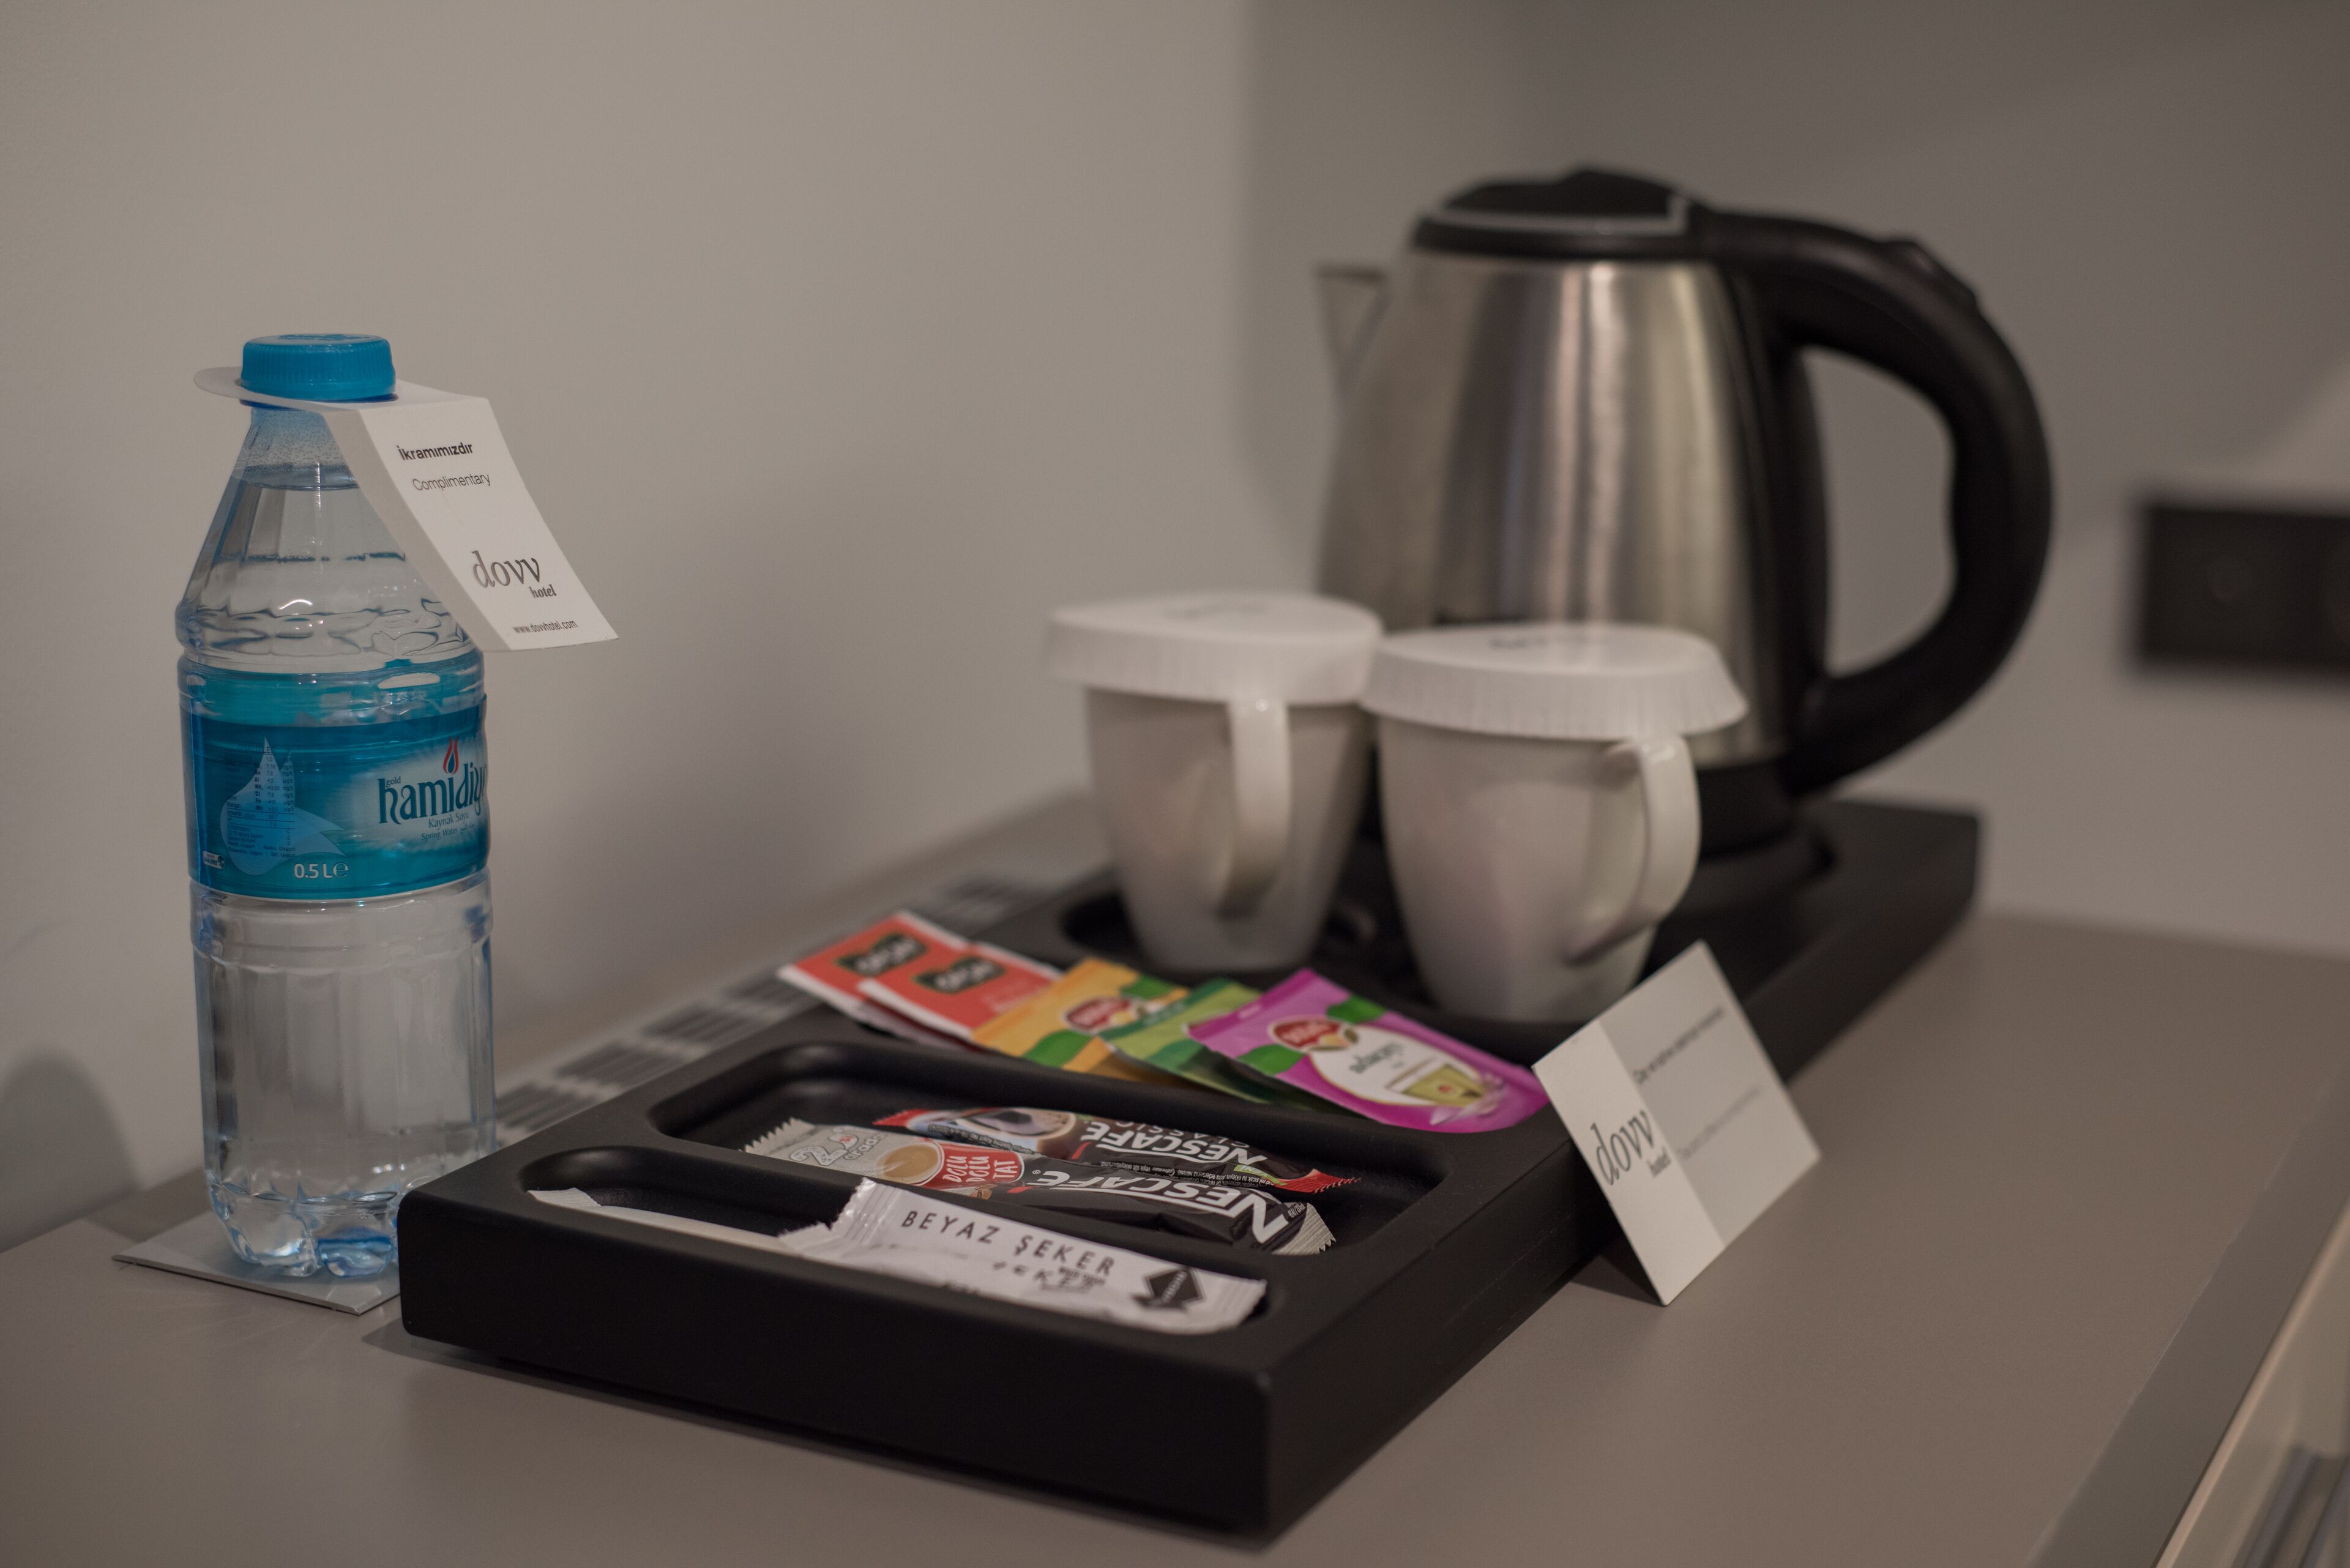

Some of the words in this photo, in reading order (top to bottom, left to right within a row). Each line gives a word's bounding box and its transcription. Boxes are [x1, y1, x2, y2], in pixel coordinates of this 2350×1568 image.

[397, 442, 474, 460] İkramımızdır
[412, 472, 491, 491] Complimentary
[529, 584, 557, 599] hotel
[386, 776, 401, 788] gold
[377, 762, 487, 825] hamidiy
[428, 815, 454, 831] Kaynak
[456, 812, 469, 824] Suyu
[421, 831, 441, 842] Spring
[442, 828, 457, 837] Water
[294, 863, 318, 879] 0.5
[993, 1160, 1018, 1179] TAT
[901, 1210, 1000, 1245] BEYAZ
[1013, 1234, 1116, 1278] ŞEKER
